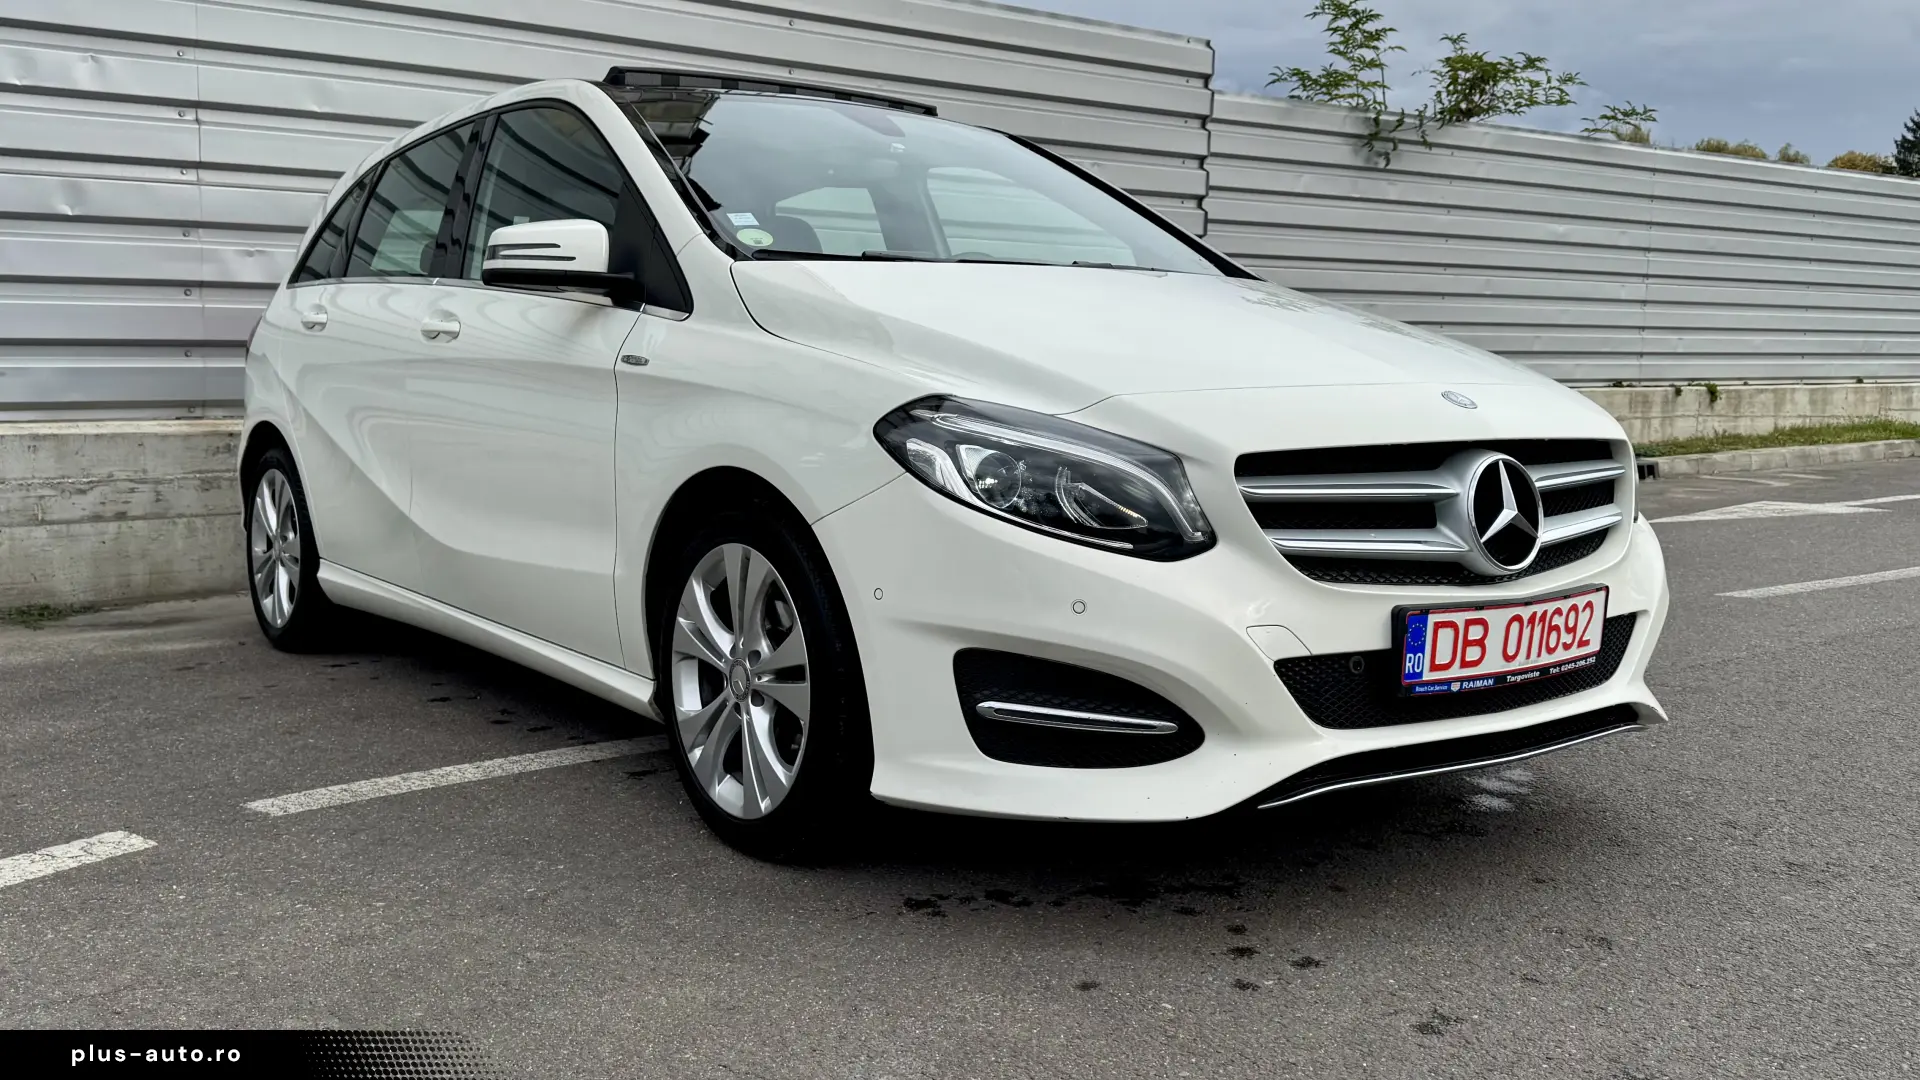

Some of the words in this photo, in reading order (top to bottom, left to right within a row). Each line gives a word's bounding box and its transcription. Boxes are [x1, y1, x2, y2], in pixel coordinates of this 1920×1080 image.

[1429, 617, 1490, 673] DB
[1502, 600, 1595, 663] 011692
[1405, 652, 1424, 674] RO
[1462, 678, 1494, 689] RAIMAN
[1506, 671, 1540, 682] Targoviste
